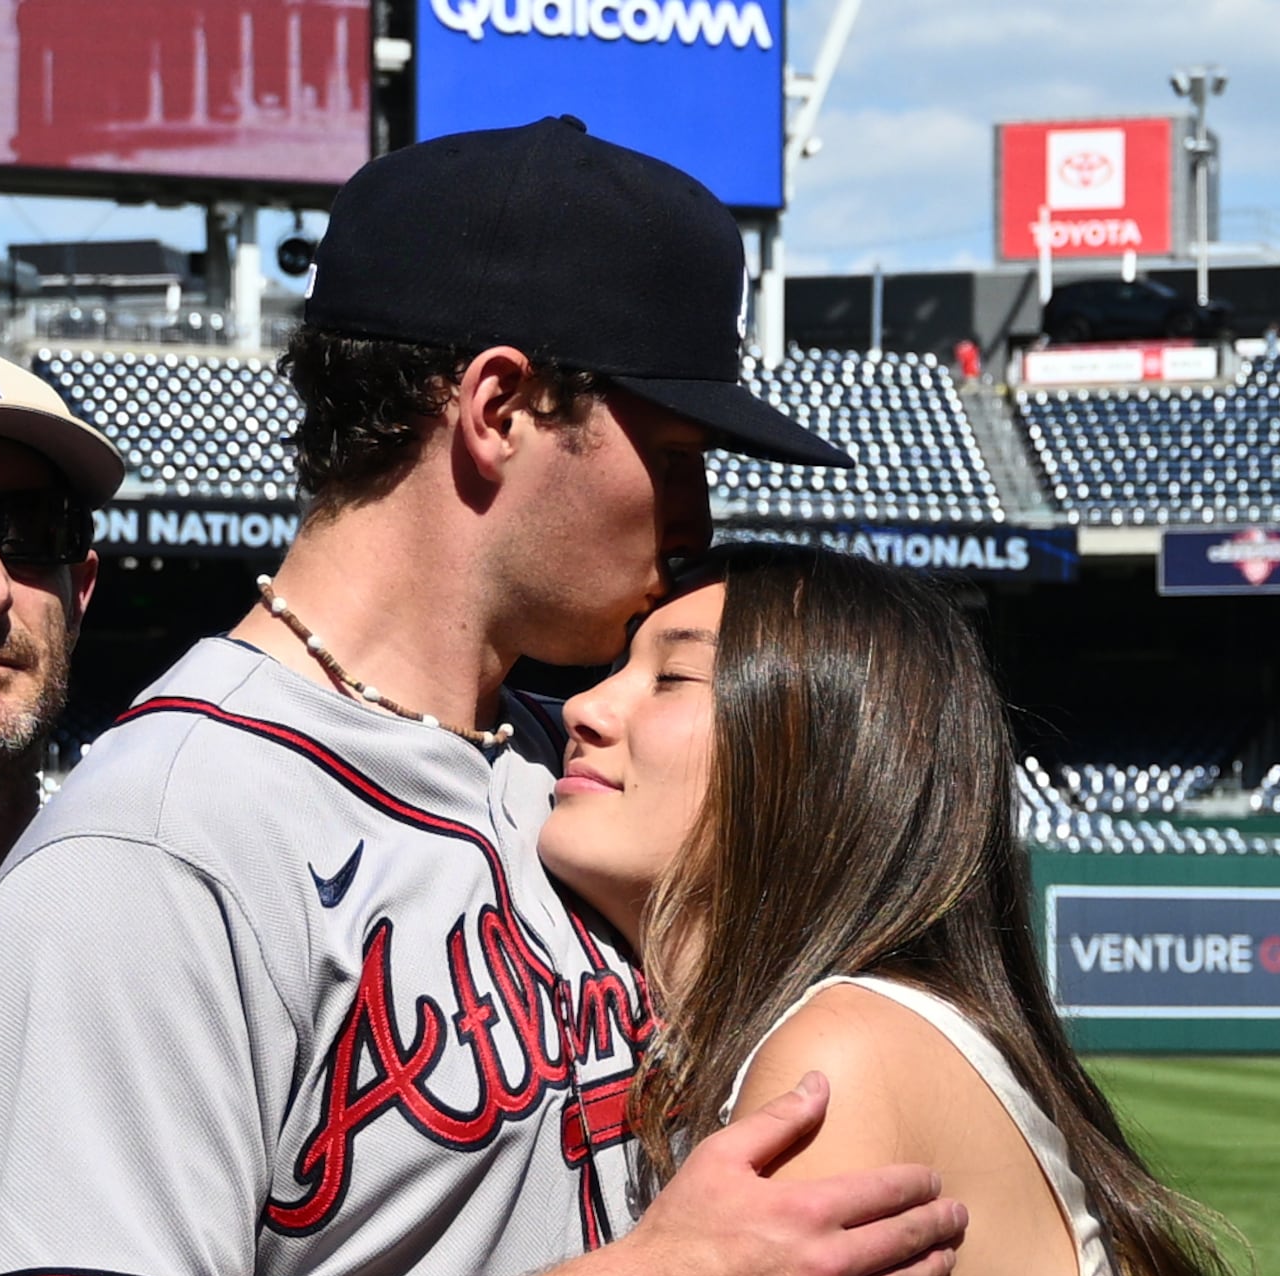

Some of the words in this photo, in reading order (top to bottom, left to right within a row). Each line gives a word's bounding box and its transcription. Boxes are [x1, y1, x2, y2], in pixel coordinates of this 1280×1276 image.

[429, 0, 773, 50] Qualcomm
[1028, 219, 1142, 249] TOYOTA
[1070, 933, 1254, 974] VENTURE
